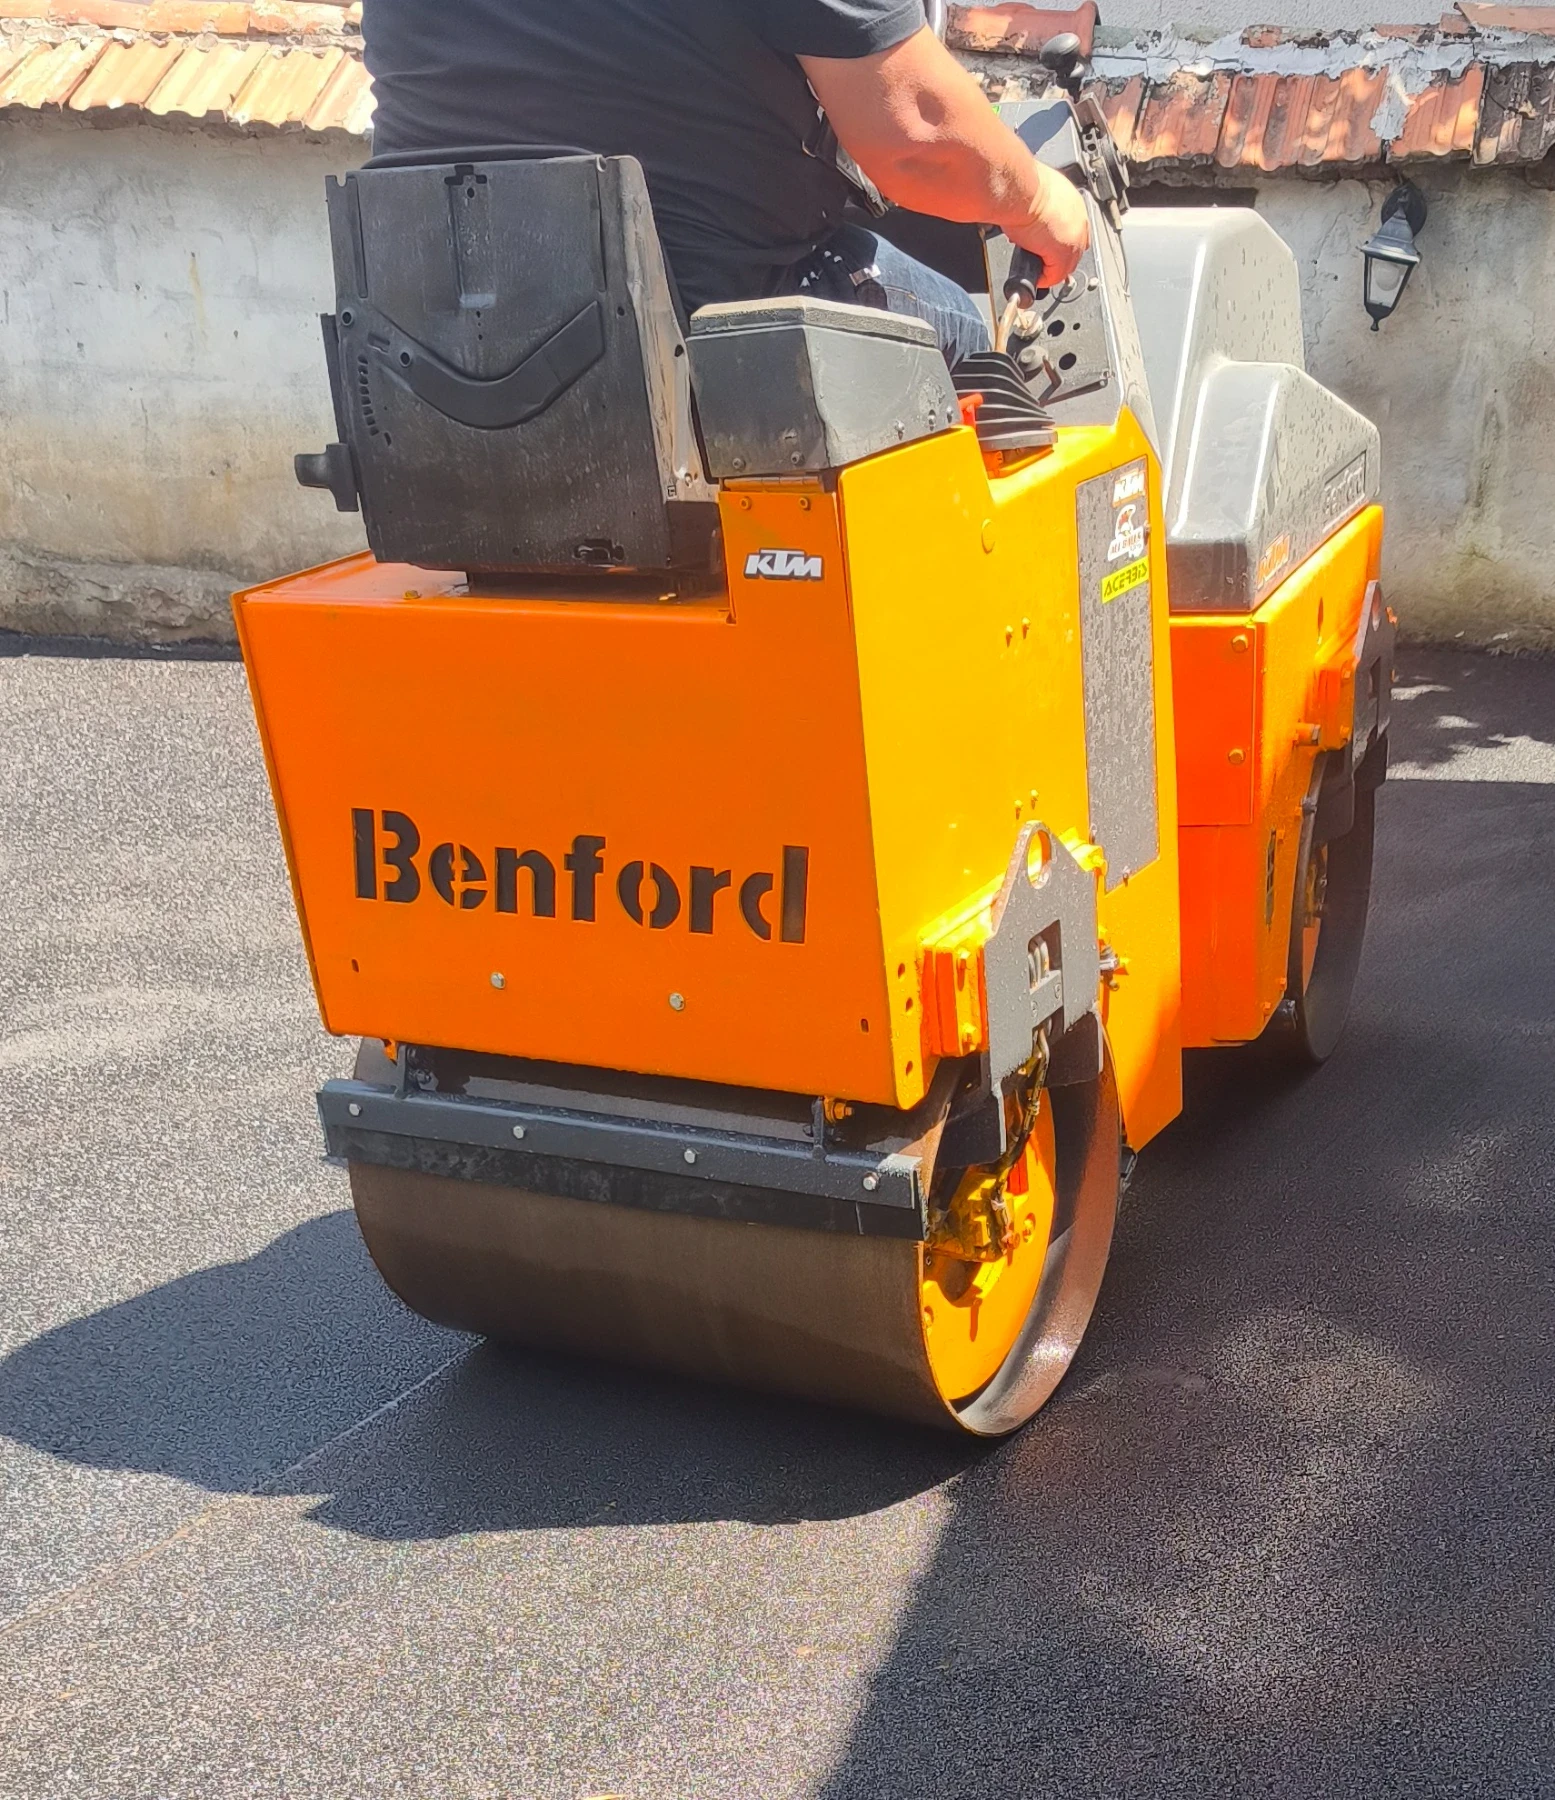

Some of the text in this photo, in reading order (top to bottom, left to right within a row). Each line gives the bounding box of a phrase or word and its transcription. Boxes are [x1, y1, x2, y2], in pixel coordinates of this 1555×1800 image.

[745, 549, 822, 577] KTM
[1104, 562, 1148, 598] ACERBIS
[351, 807, 809, 944] Benford
